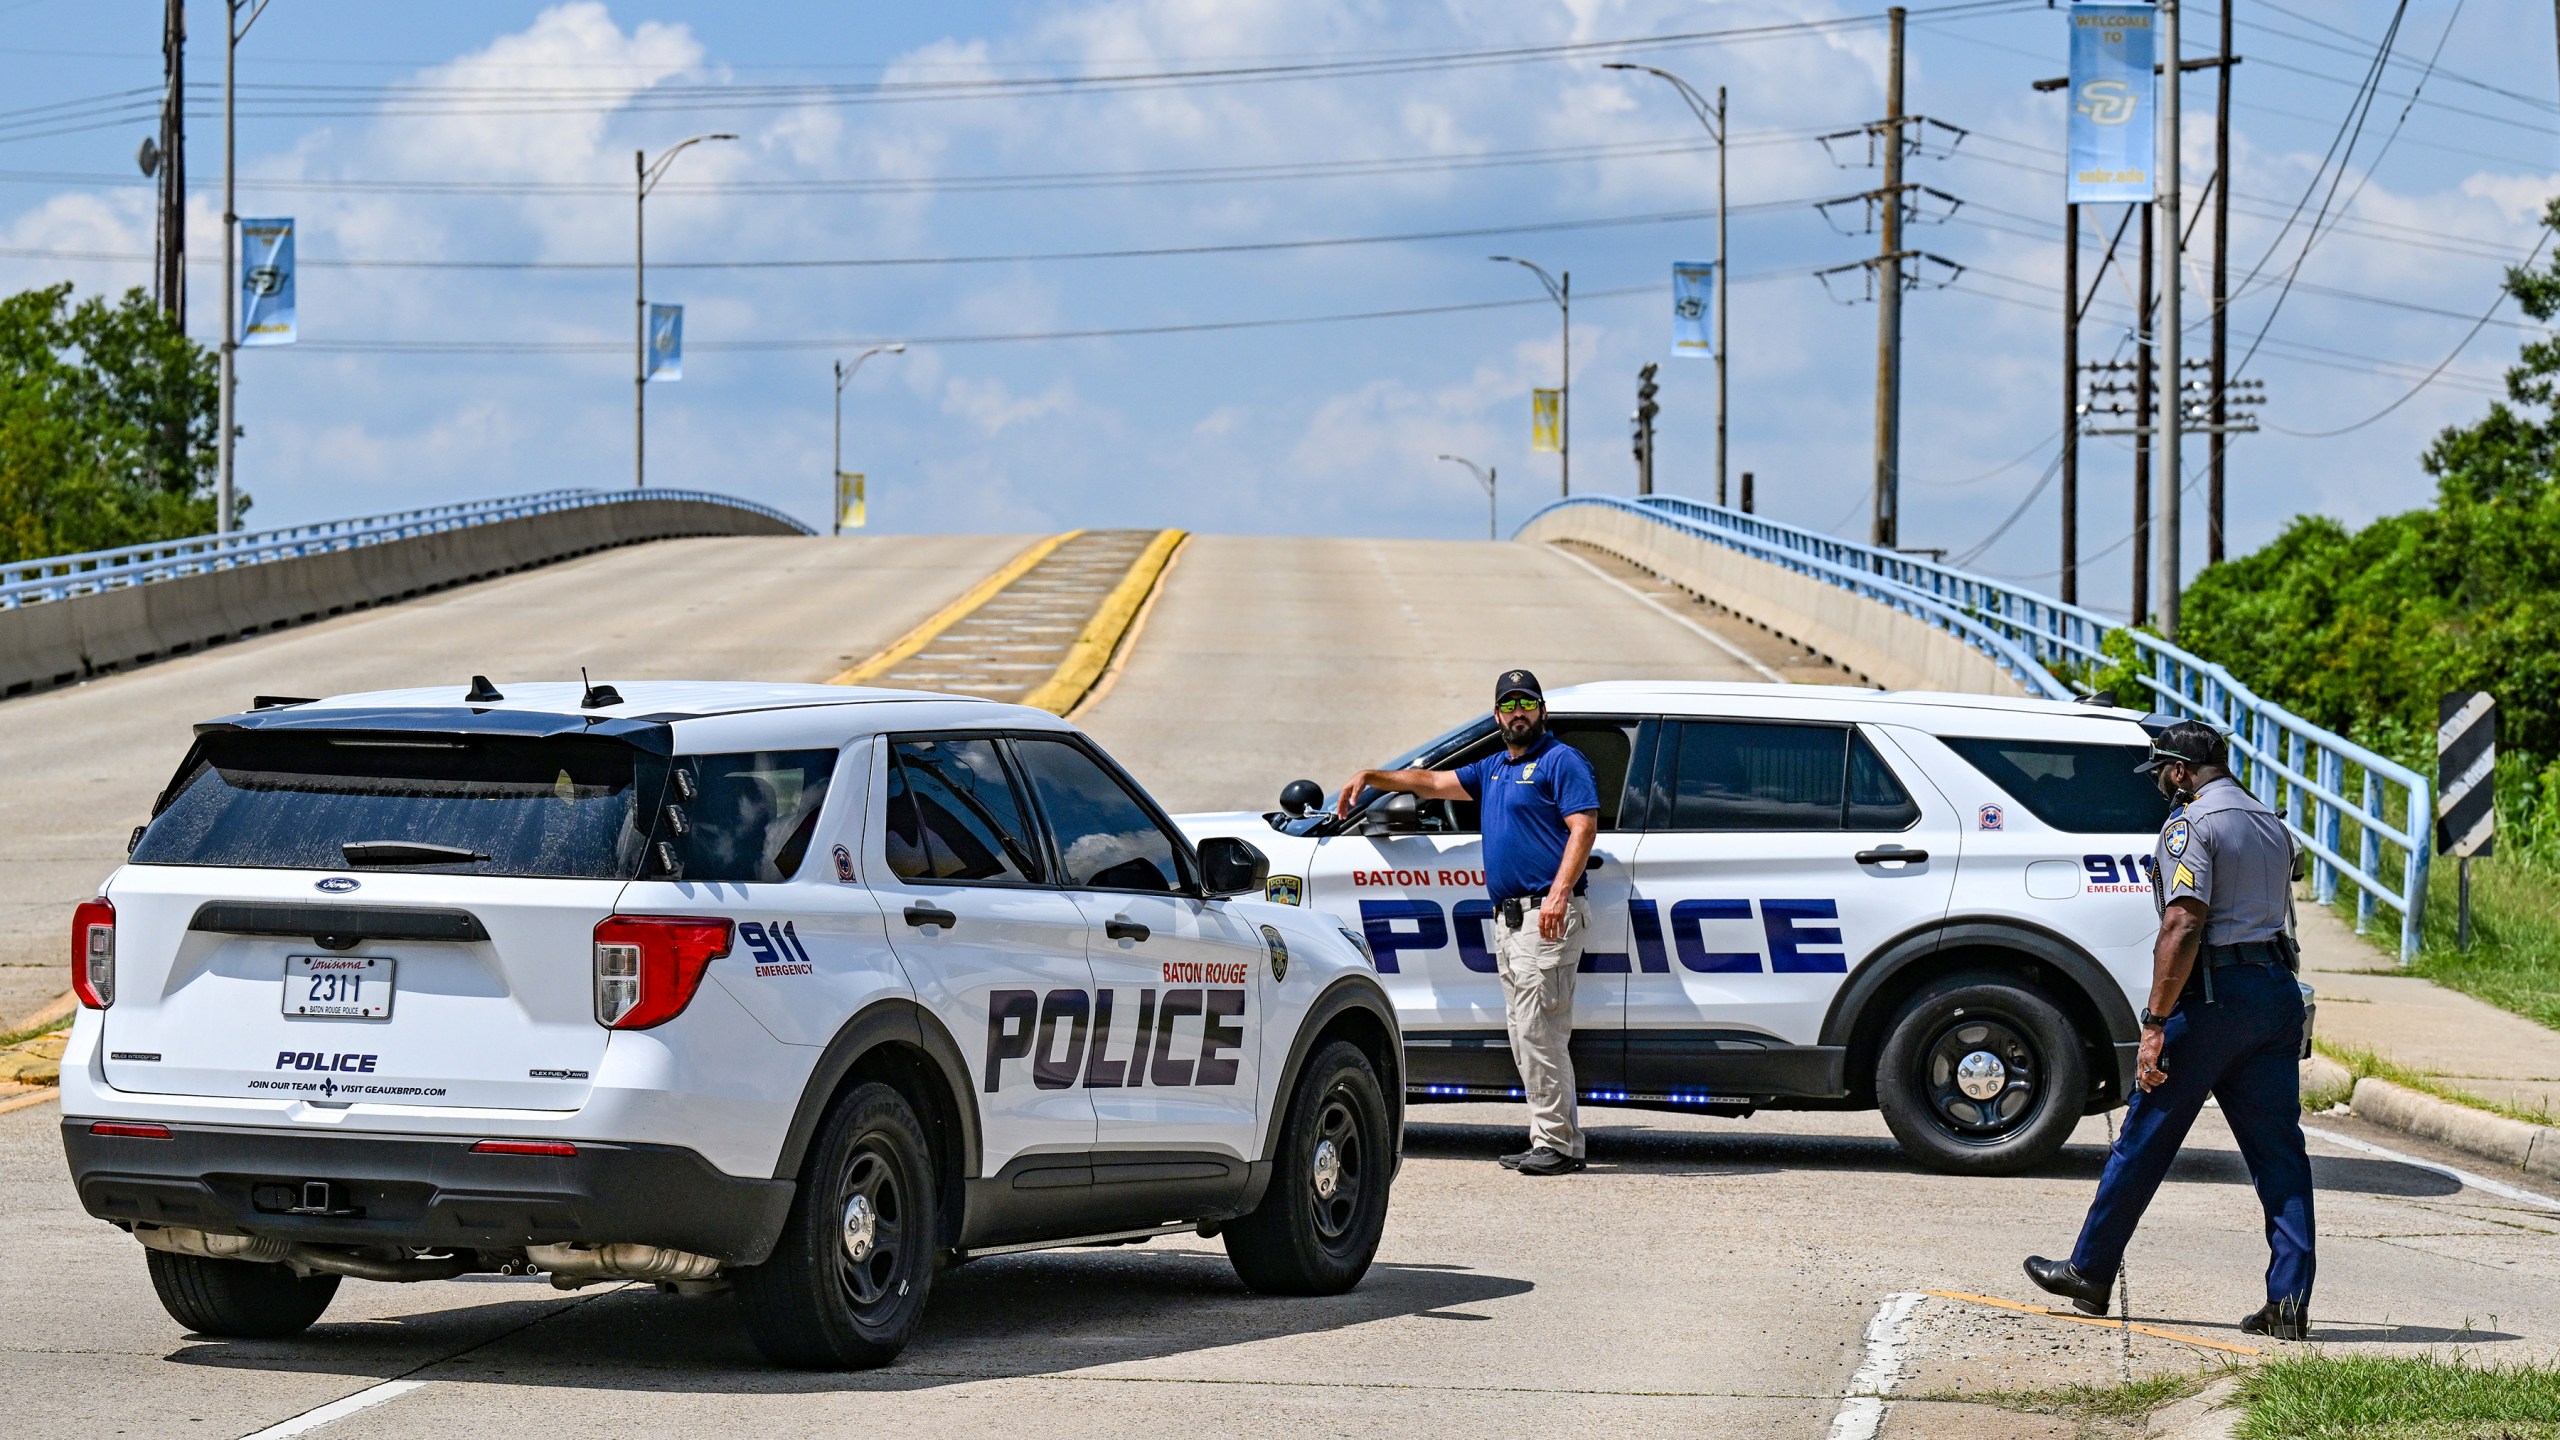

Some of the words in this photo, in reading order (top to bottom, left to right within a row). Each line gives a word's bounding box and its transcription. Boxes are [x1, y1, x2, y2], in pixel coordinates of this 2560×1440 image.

[2076, 15, 2149, 28] WELCOME
[2103, 31, 2123, 43] TO
[2076, 80, 2138, 126] SU
[1353, 870, 1431, 886] BATON
[1438, 870, 1487, 886] ROU
[2087, 885, 2152, 893] EMERGENC
[738, 921, 811, 963] 911
[1359, 900, 1848, 974] PICE
[311, 958, 366, 971] Louisiana
[755, 964, 813, 977] EMERGENCY
[1163, 963, 1202, 983] BATON
[1206, 963, 1248, 984] ROUGE
[309, 974, 361, 1002] 2311
[325, 1006, 341, 1014] ROUGE
[984, 989, 1245, 1093] POLICE
[276, 1052, 378, 1073] POLICE
[248, 1080, 269, 1089] JOIN
[270, 1081, 289, 1090] OUR
[291, 1082, 317, 1091] TEAM
[340, 1084, 364, 1094] VISIT
[364, 1085, 447, 1097] GEAUXBRPD.COM
